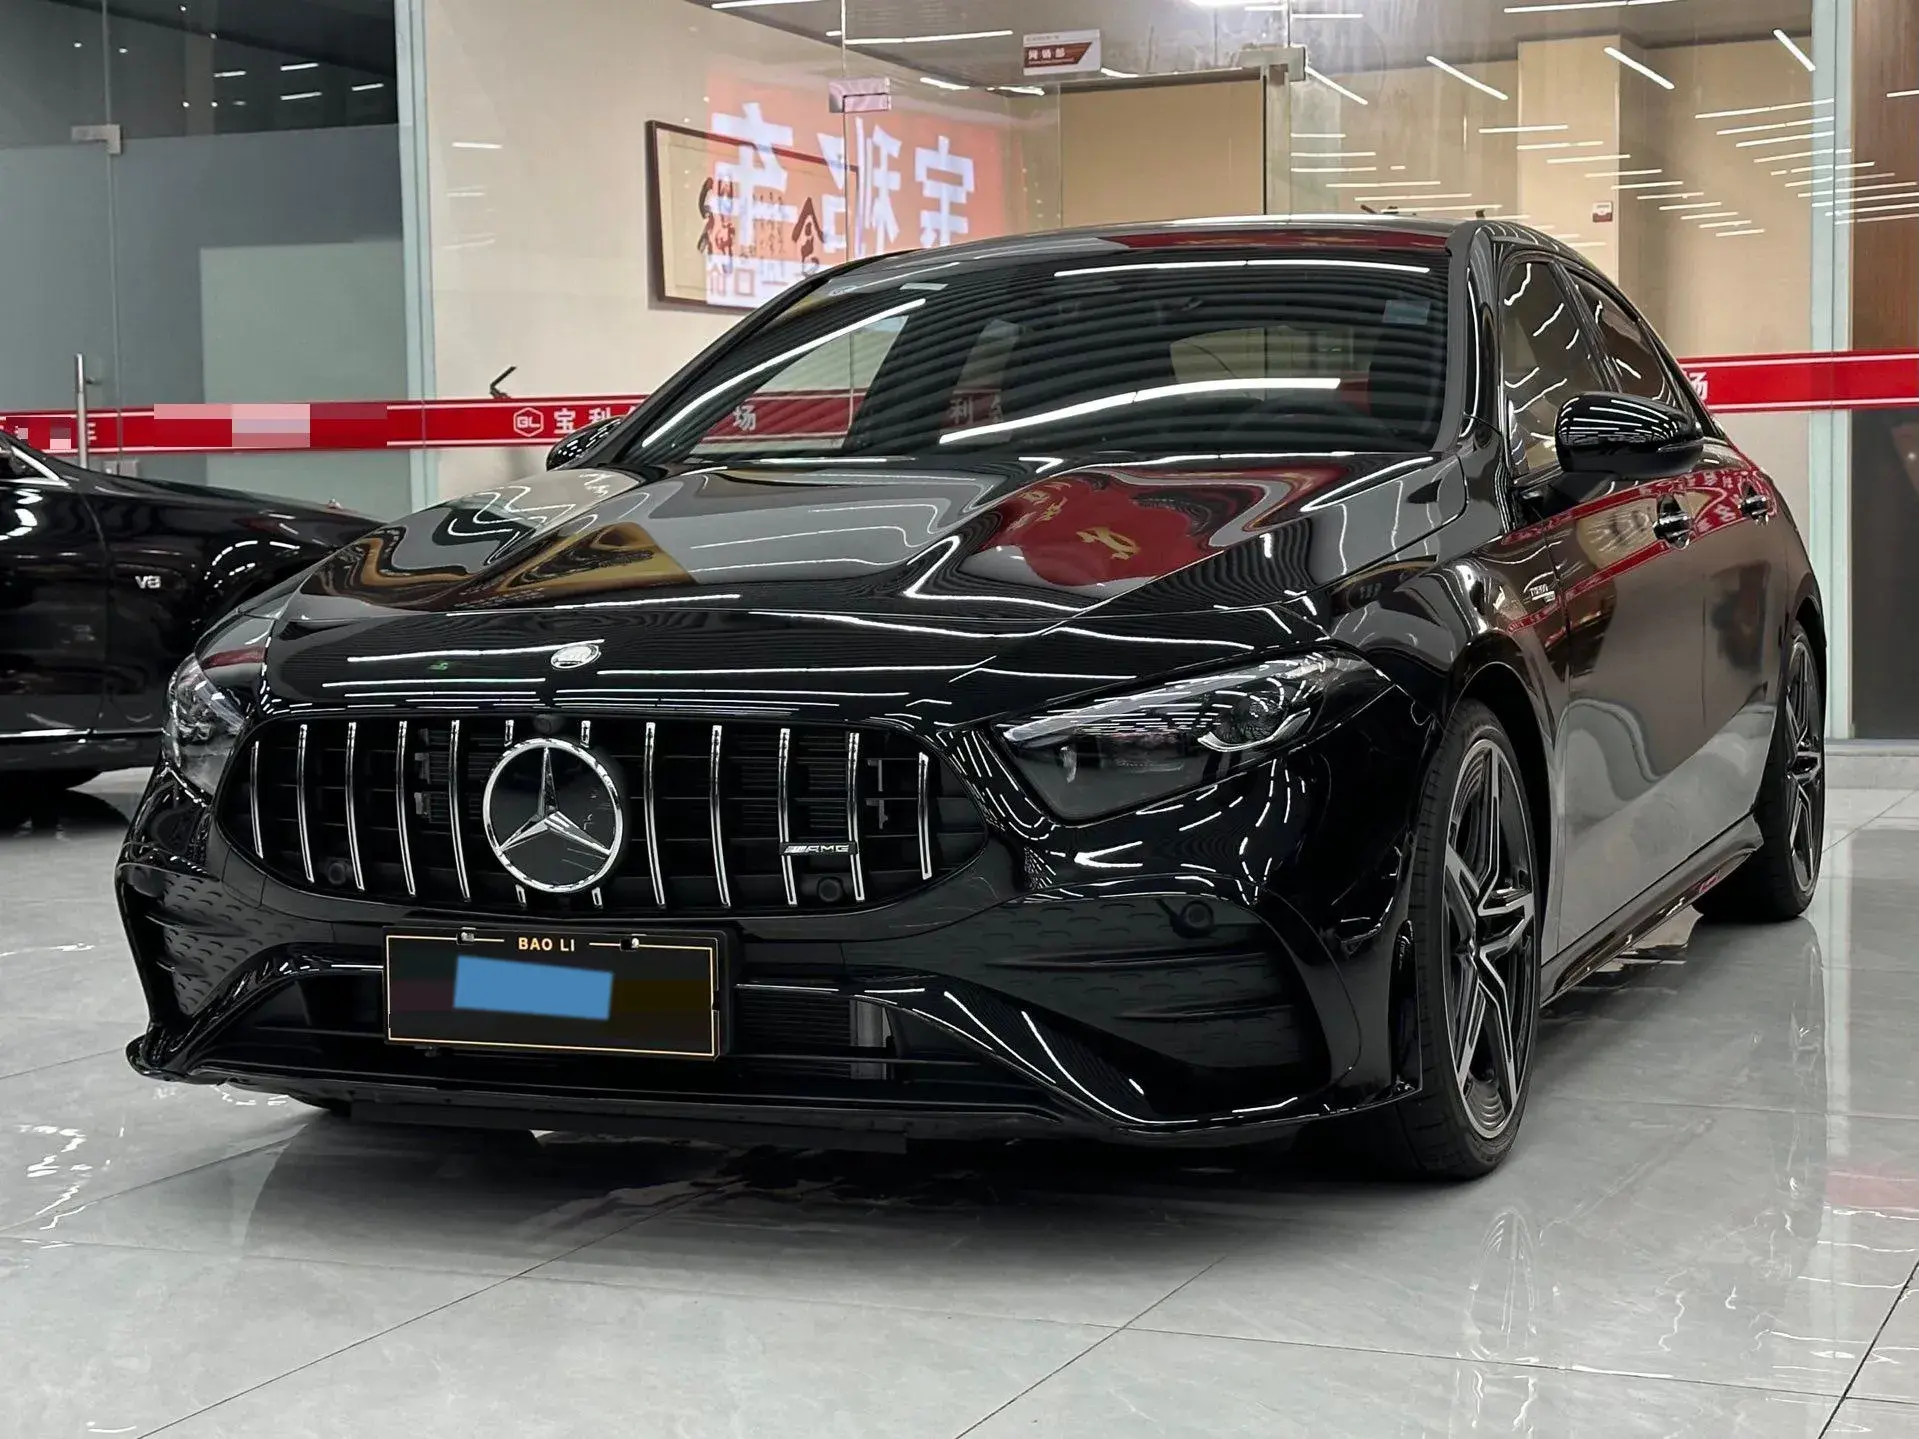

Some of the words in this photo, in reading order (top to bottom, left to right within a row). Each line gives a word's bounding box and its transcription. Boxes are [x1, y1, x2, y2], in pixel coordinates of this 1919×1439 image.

[732, 404, 757, 431] 场
[804, 844, 849, 853] AMG
[518, 937, 553, 951] BAO
[560, 938, 575, 952] LI
